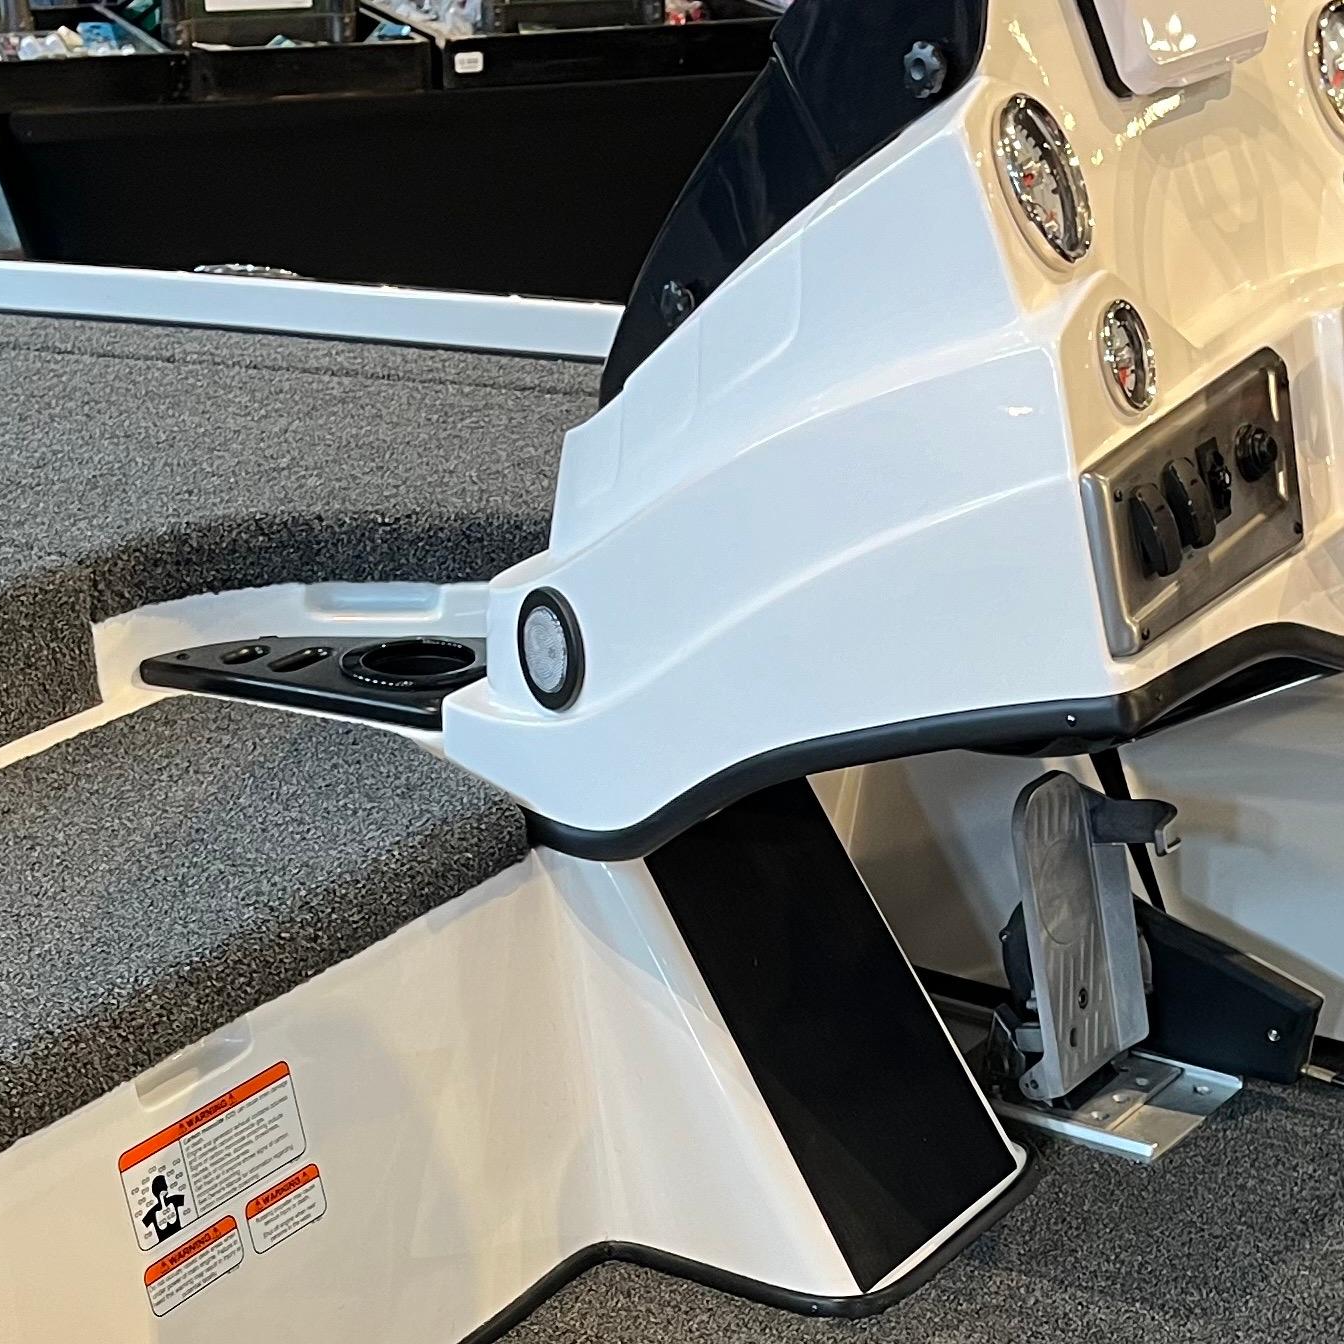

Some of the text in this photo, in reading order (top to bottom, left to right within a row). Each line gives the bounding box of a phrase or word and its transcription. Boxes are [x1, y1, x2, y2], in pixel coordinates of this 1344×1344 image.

[185, 1099, 228, 1128] WARNING
[262, 1177, 301, 1205] WARNING
[167, 1232, 212, 1266] WARNING
